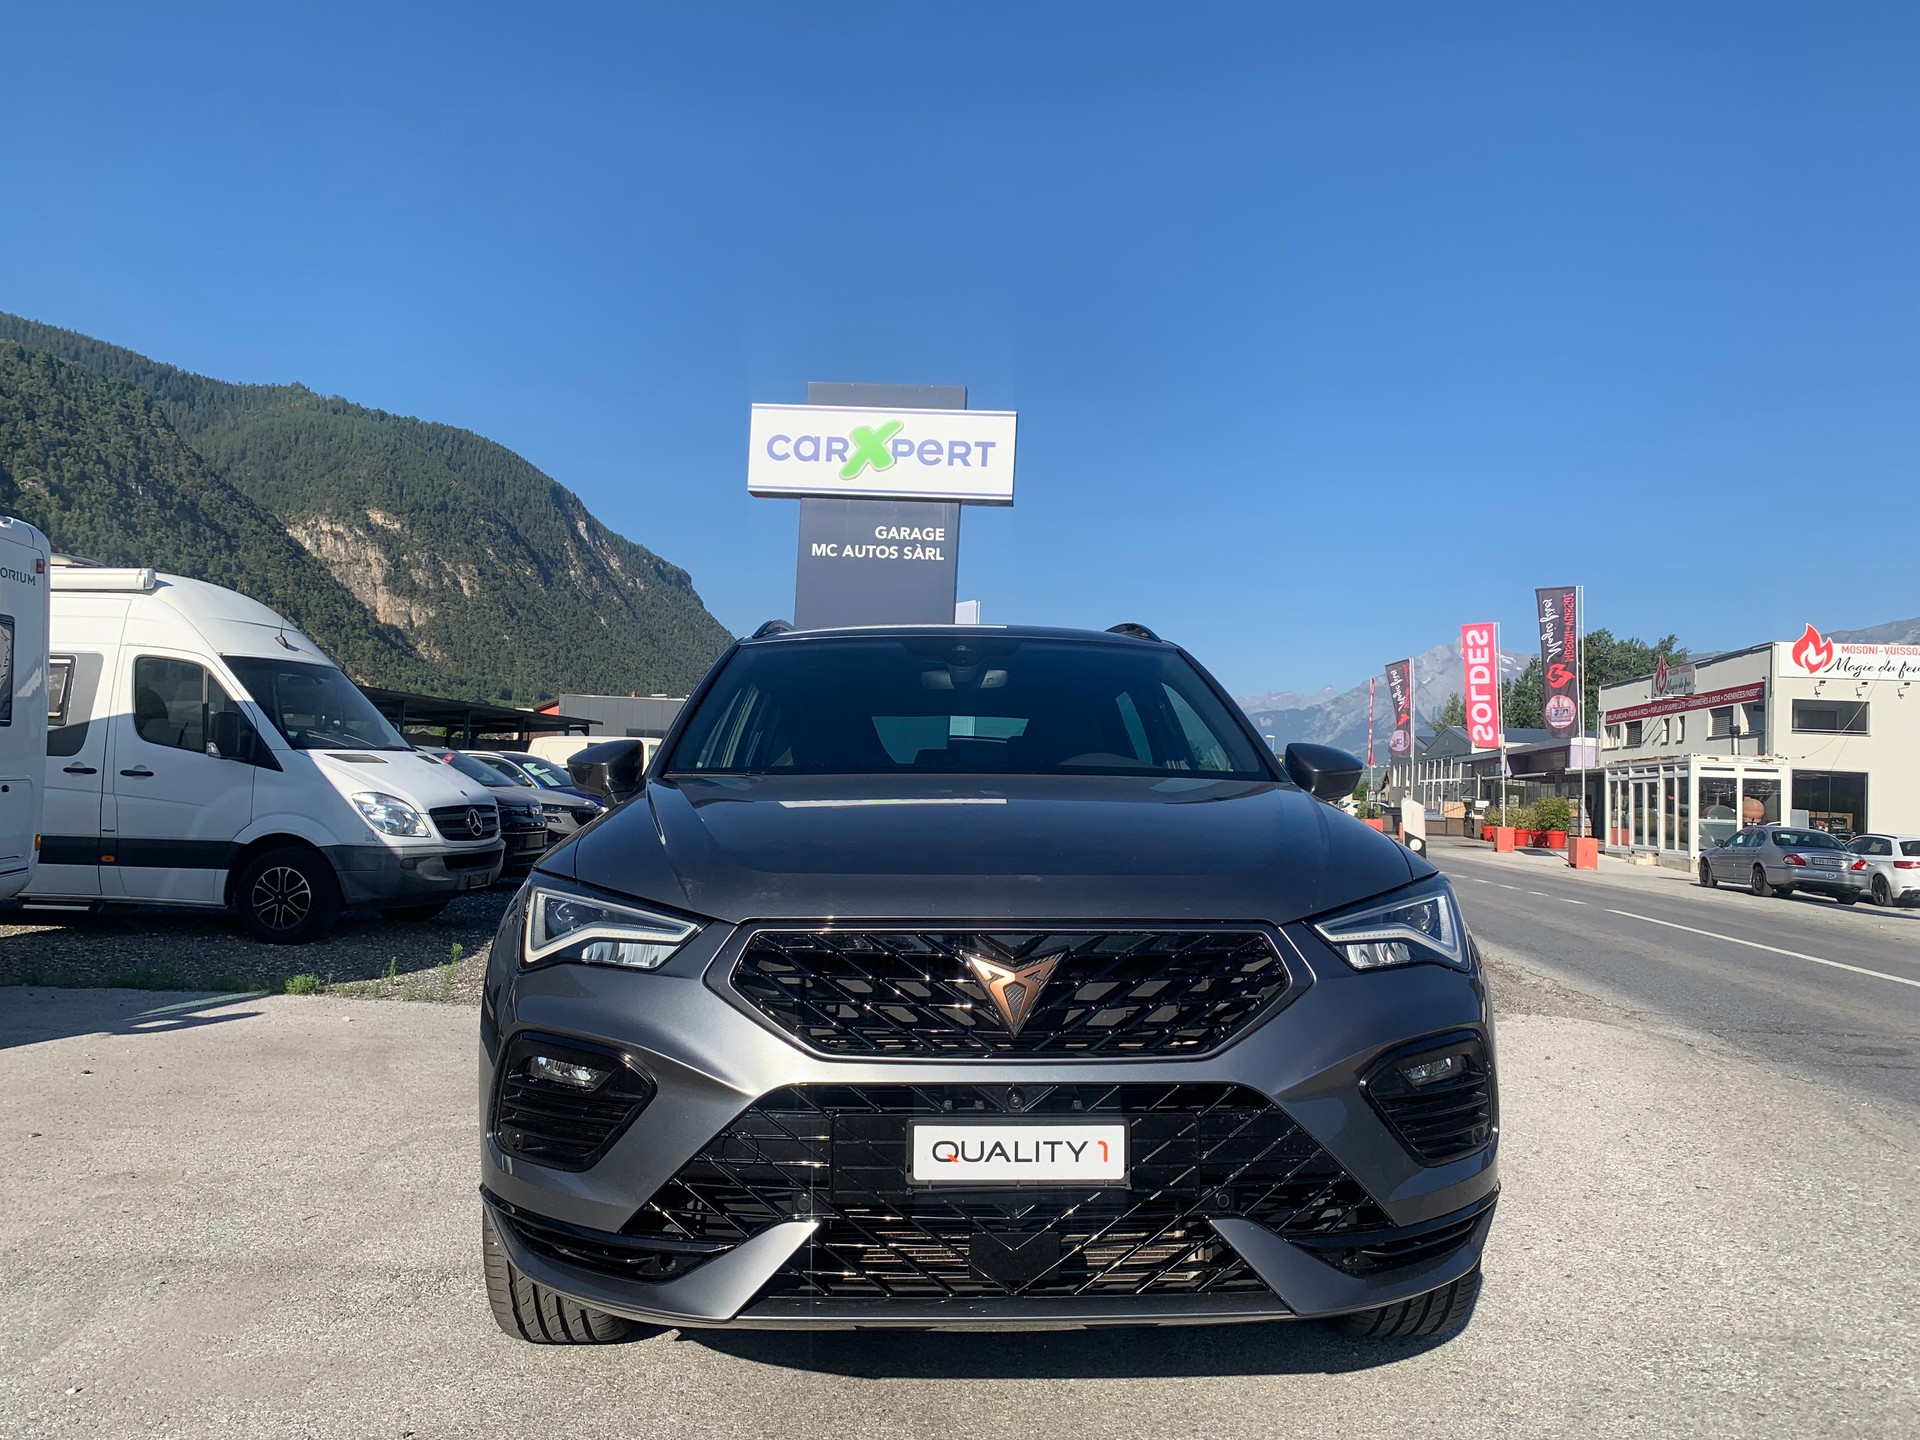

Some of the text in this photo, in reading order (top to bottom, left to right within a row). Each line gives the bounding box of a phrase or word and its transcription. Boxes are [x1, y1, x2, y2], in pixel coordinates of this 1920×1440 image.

[875, 525, 945, 541] GARAGE
[811, 543, 838, 557] MC
[842, 544, 899, 560] AUTOS
[1824, 656, 1875, 678] Magie
[1878, 660, 1898, 673] du
